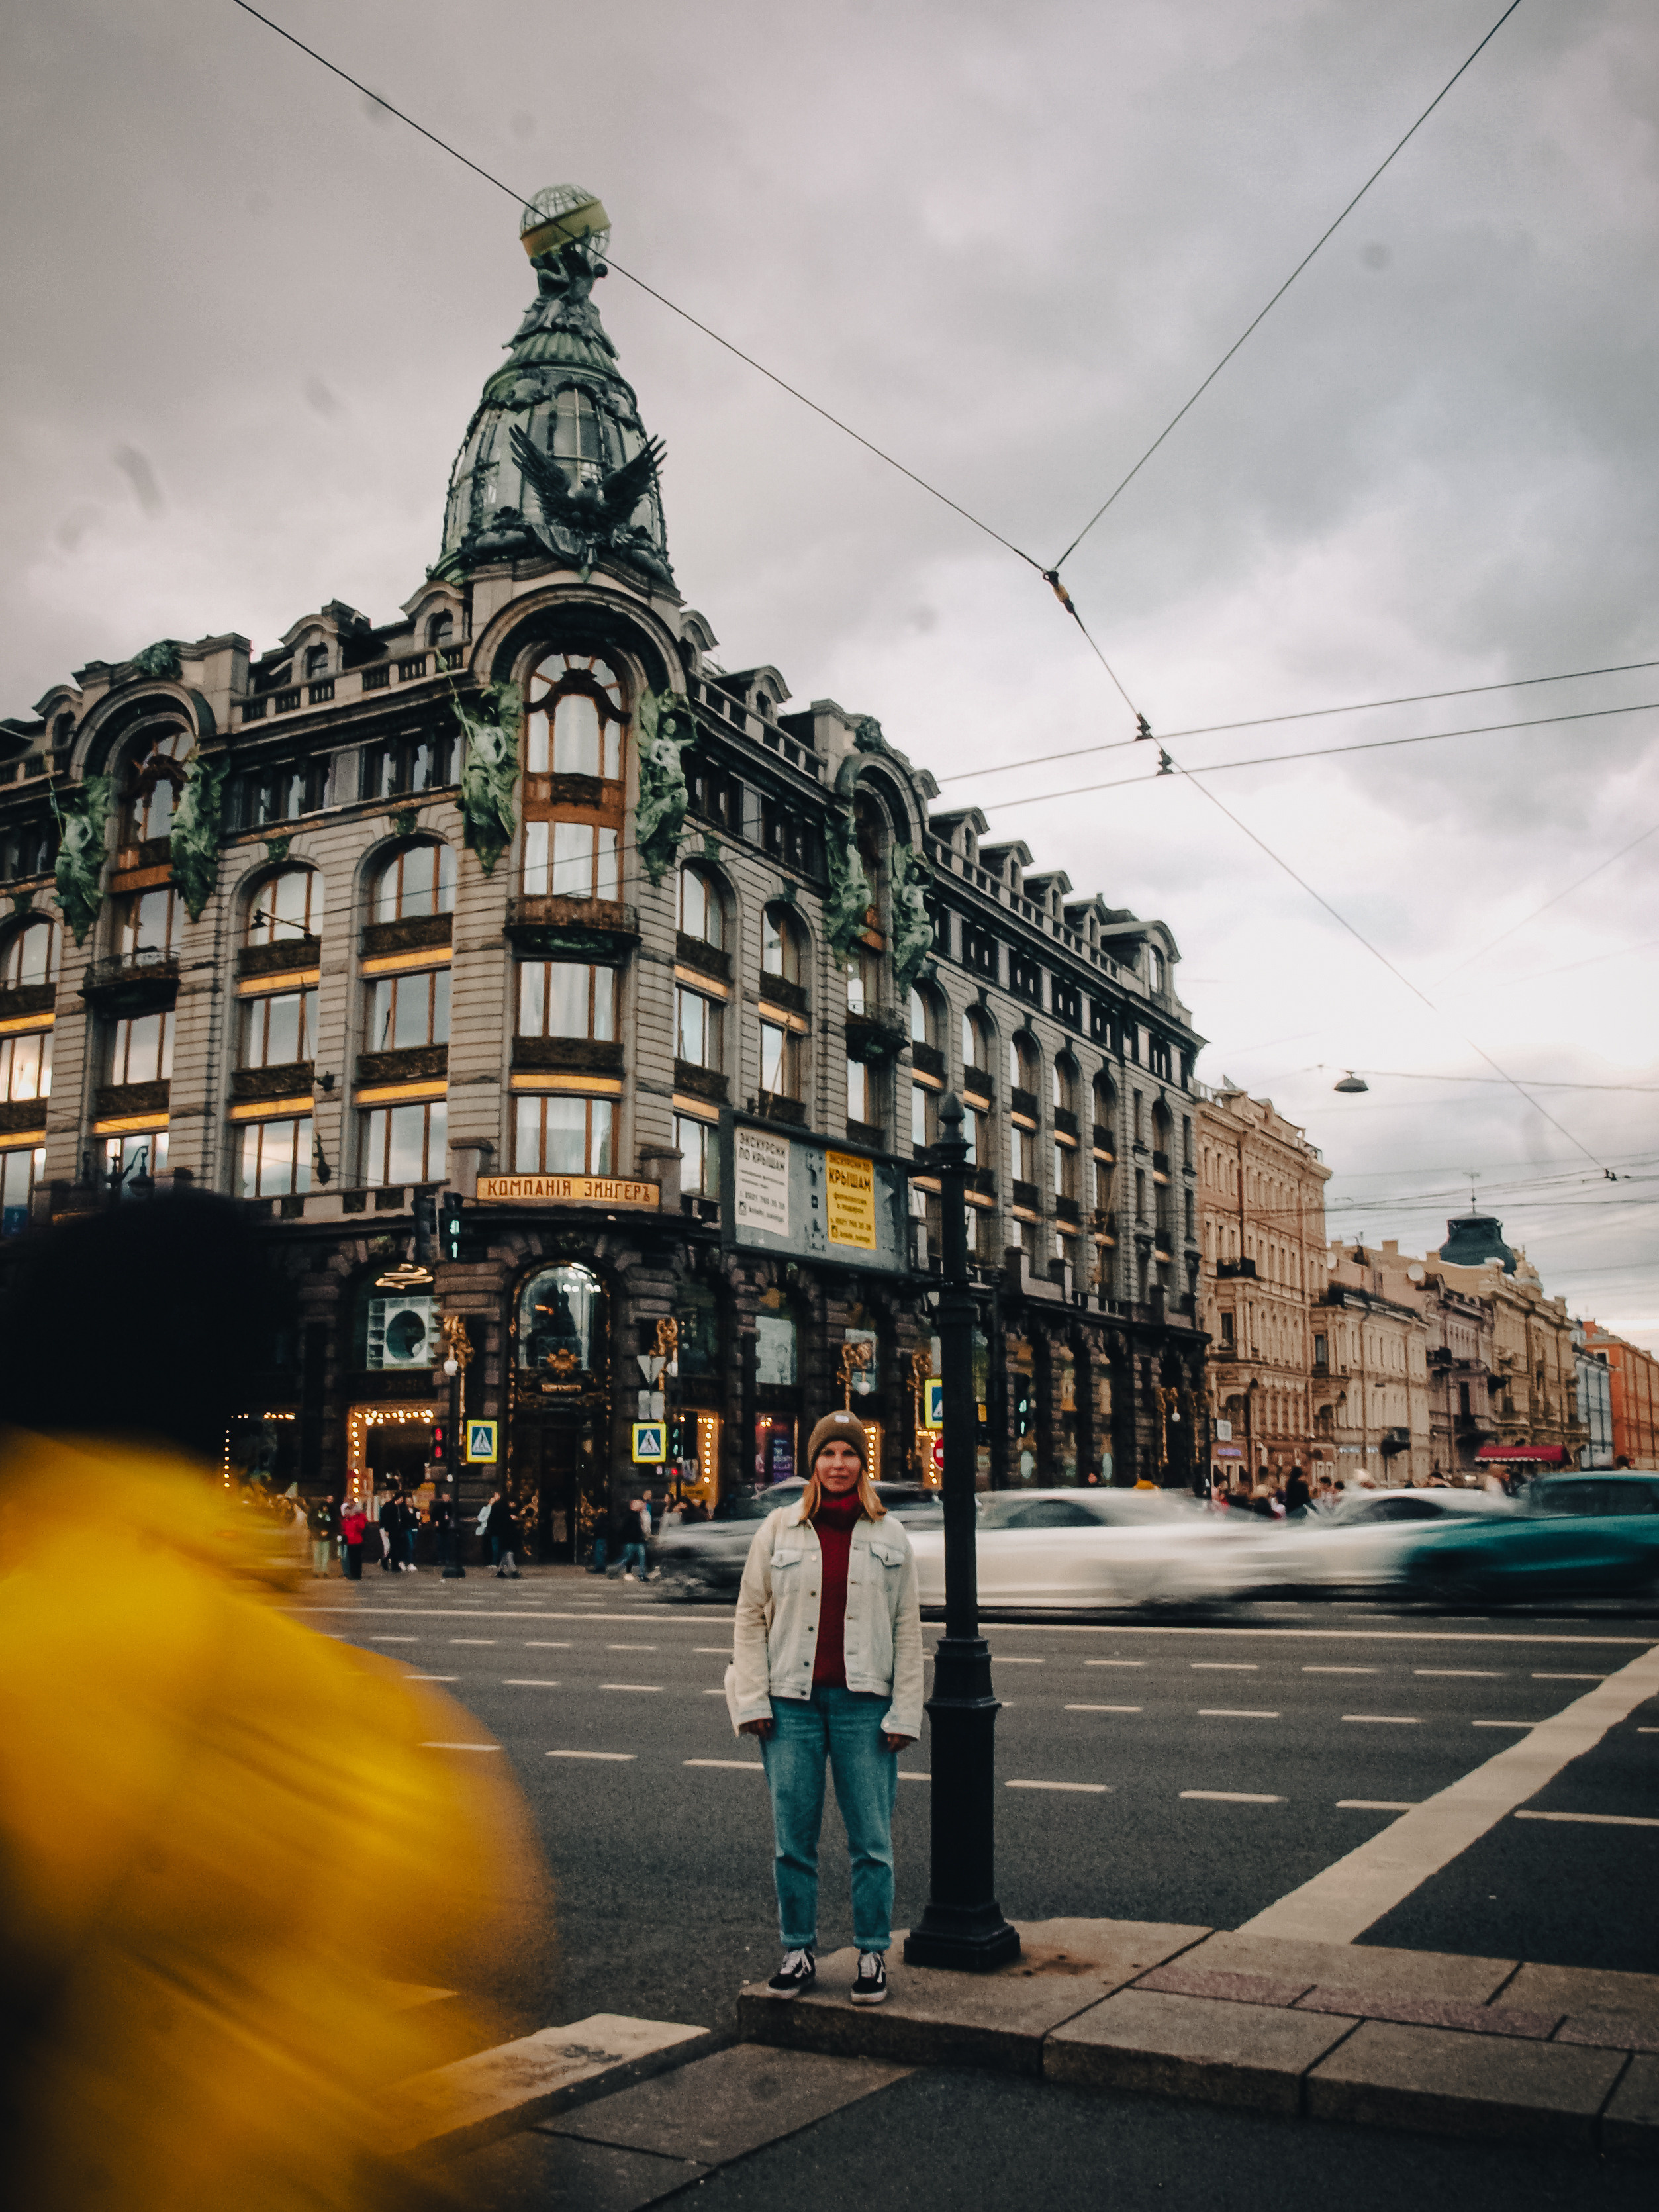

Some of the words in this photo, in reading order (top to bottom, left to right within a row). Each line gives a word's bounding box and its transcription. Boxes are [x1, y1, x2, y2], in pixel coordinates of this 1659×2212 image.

[739, 1146, 750, 1161] ПО
[752, 1151, 785, 1173] КРЫШАМ
[487, 1180, 571, 1196] КОМПАНІЯ
[584, 1181, 650, 1202] ЗИНГЕРЪ
[829, 1167, 871, 1192] КРЫШАМ
